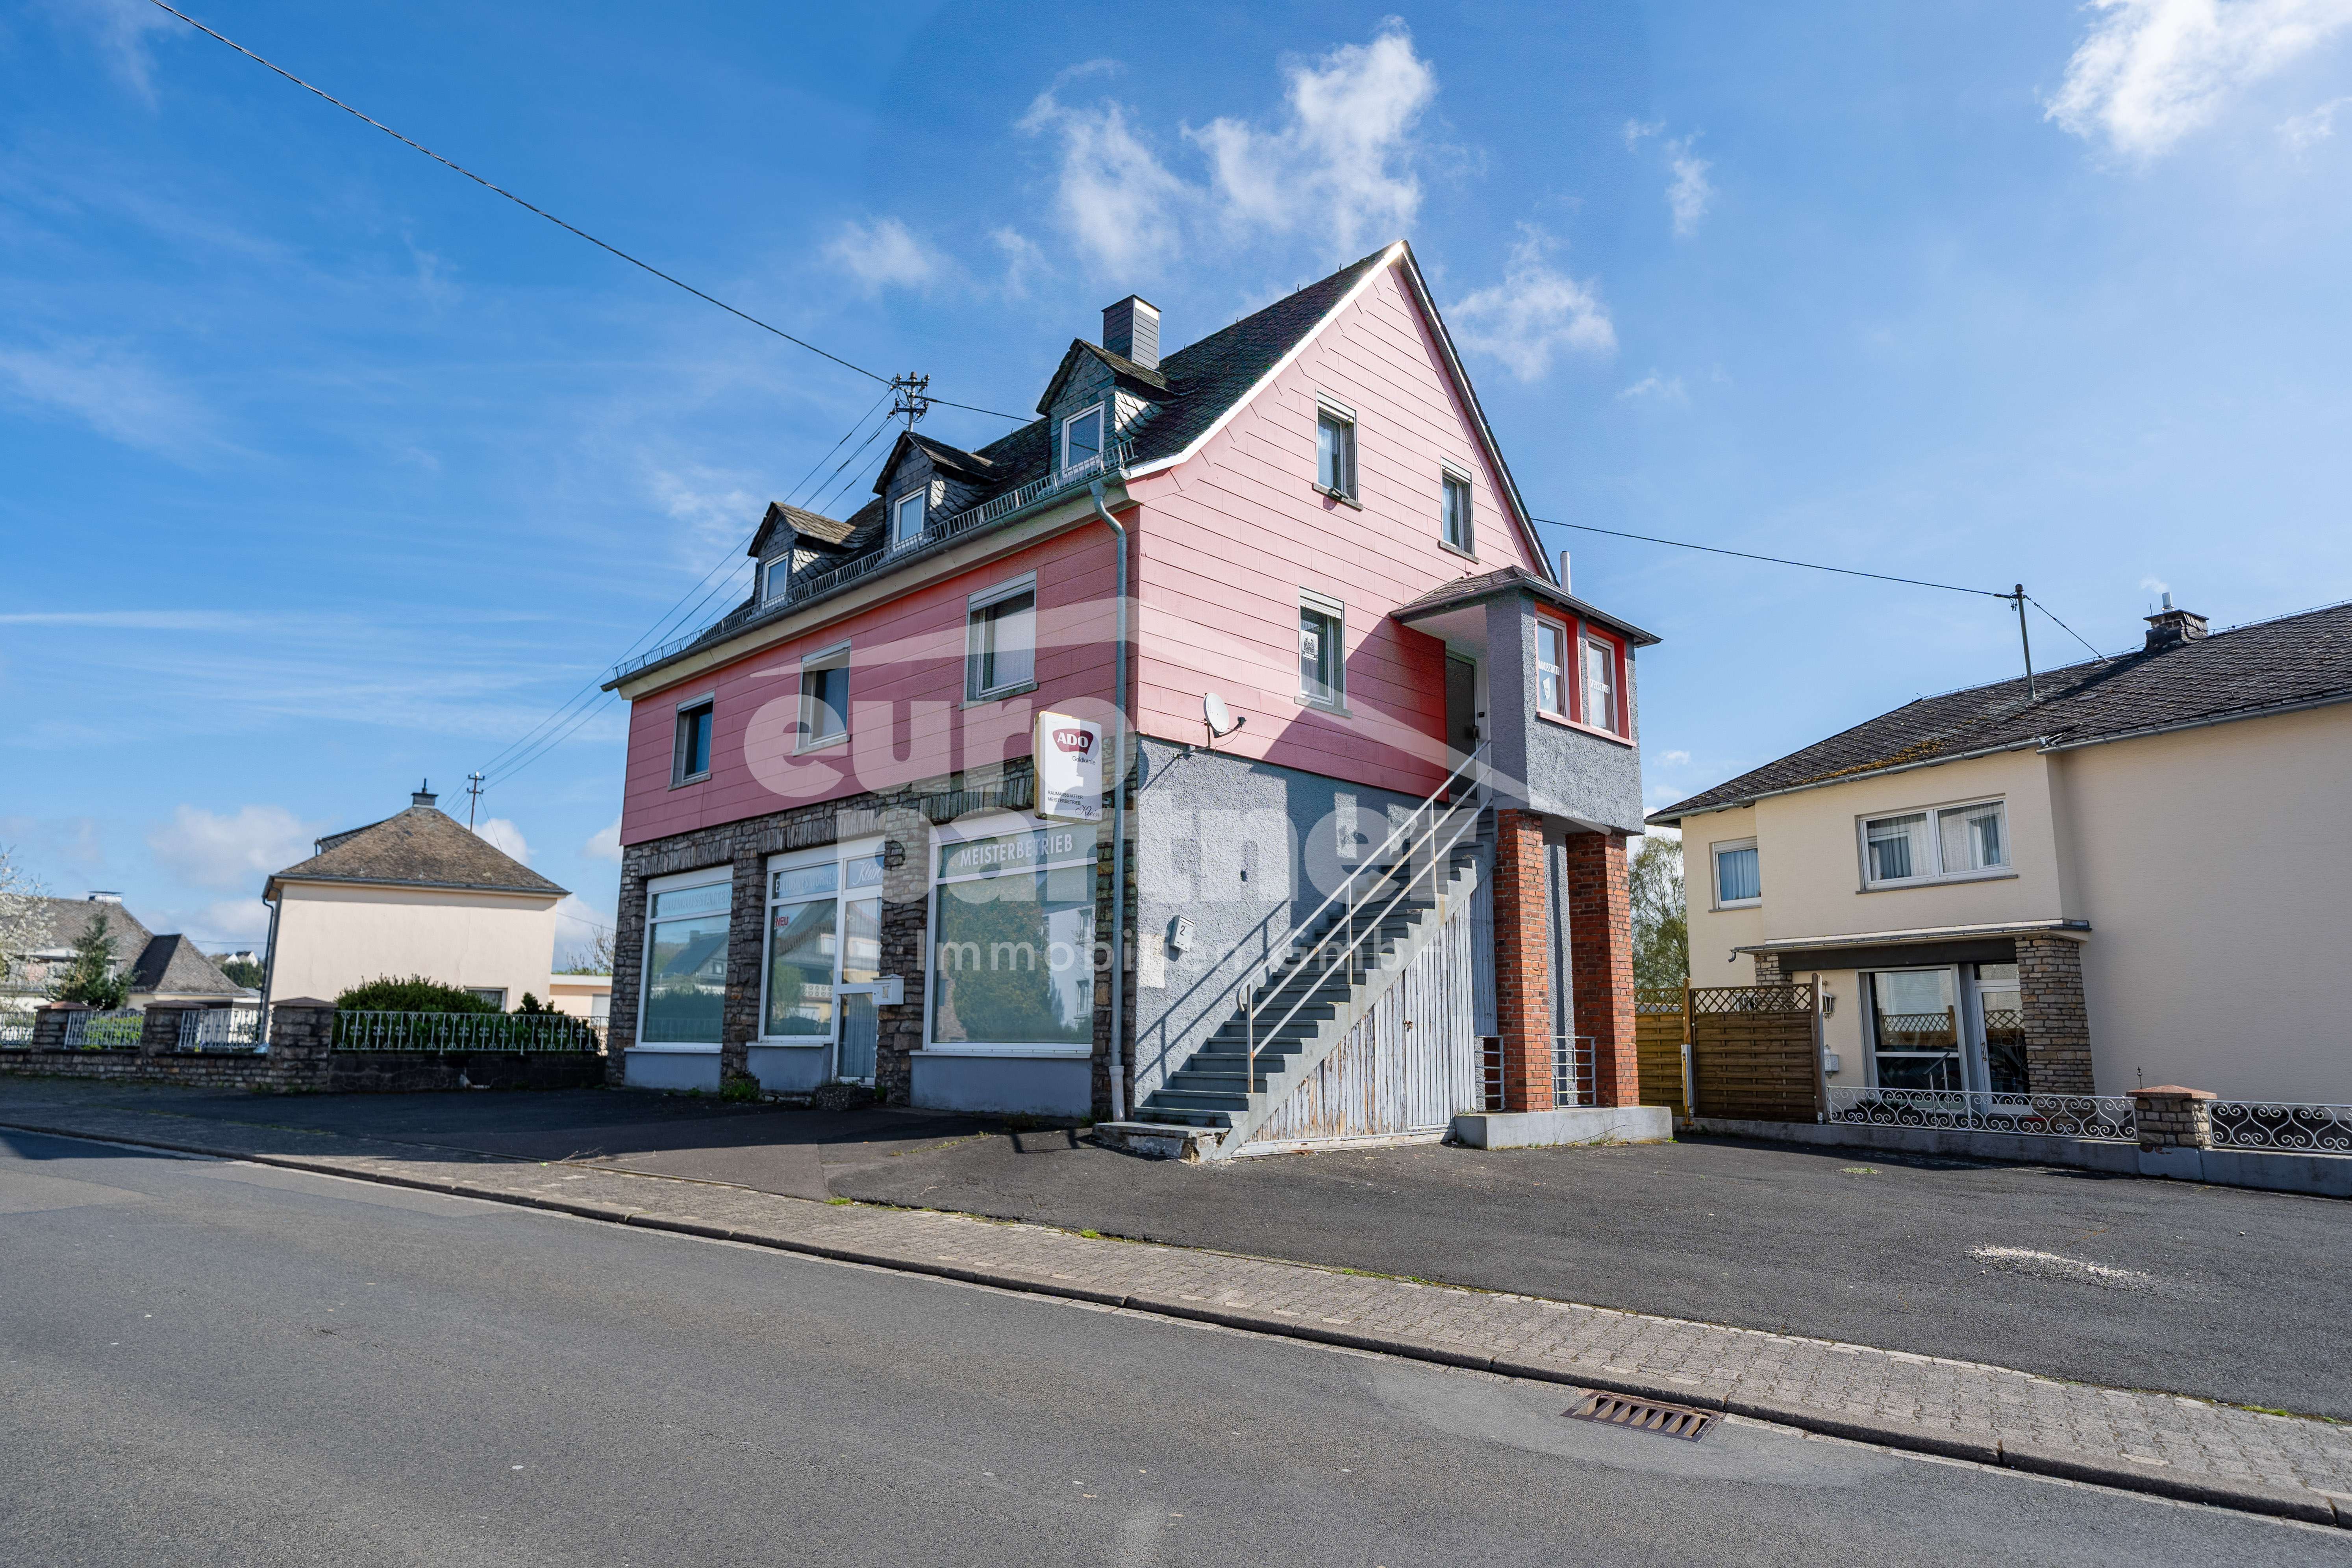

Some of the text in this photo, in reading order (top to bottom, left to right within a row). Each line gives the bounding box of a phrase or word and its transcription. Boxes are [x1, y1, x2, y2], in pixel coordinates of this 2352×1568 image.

[1057, 732, 1089, 748] ADO
[1072, 755, 1096, 765] Goldkante
[1048, 790, 1083, 799] RAUMAUSSTATTER
[1048, 797, 1081, 805] MEISTERBETRIEB
[1075, 805, 1101, 818] Klein
[960, 833, 1073, 867] MEISTERBETRIEB
[776, 916, 789, 926] NEU
